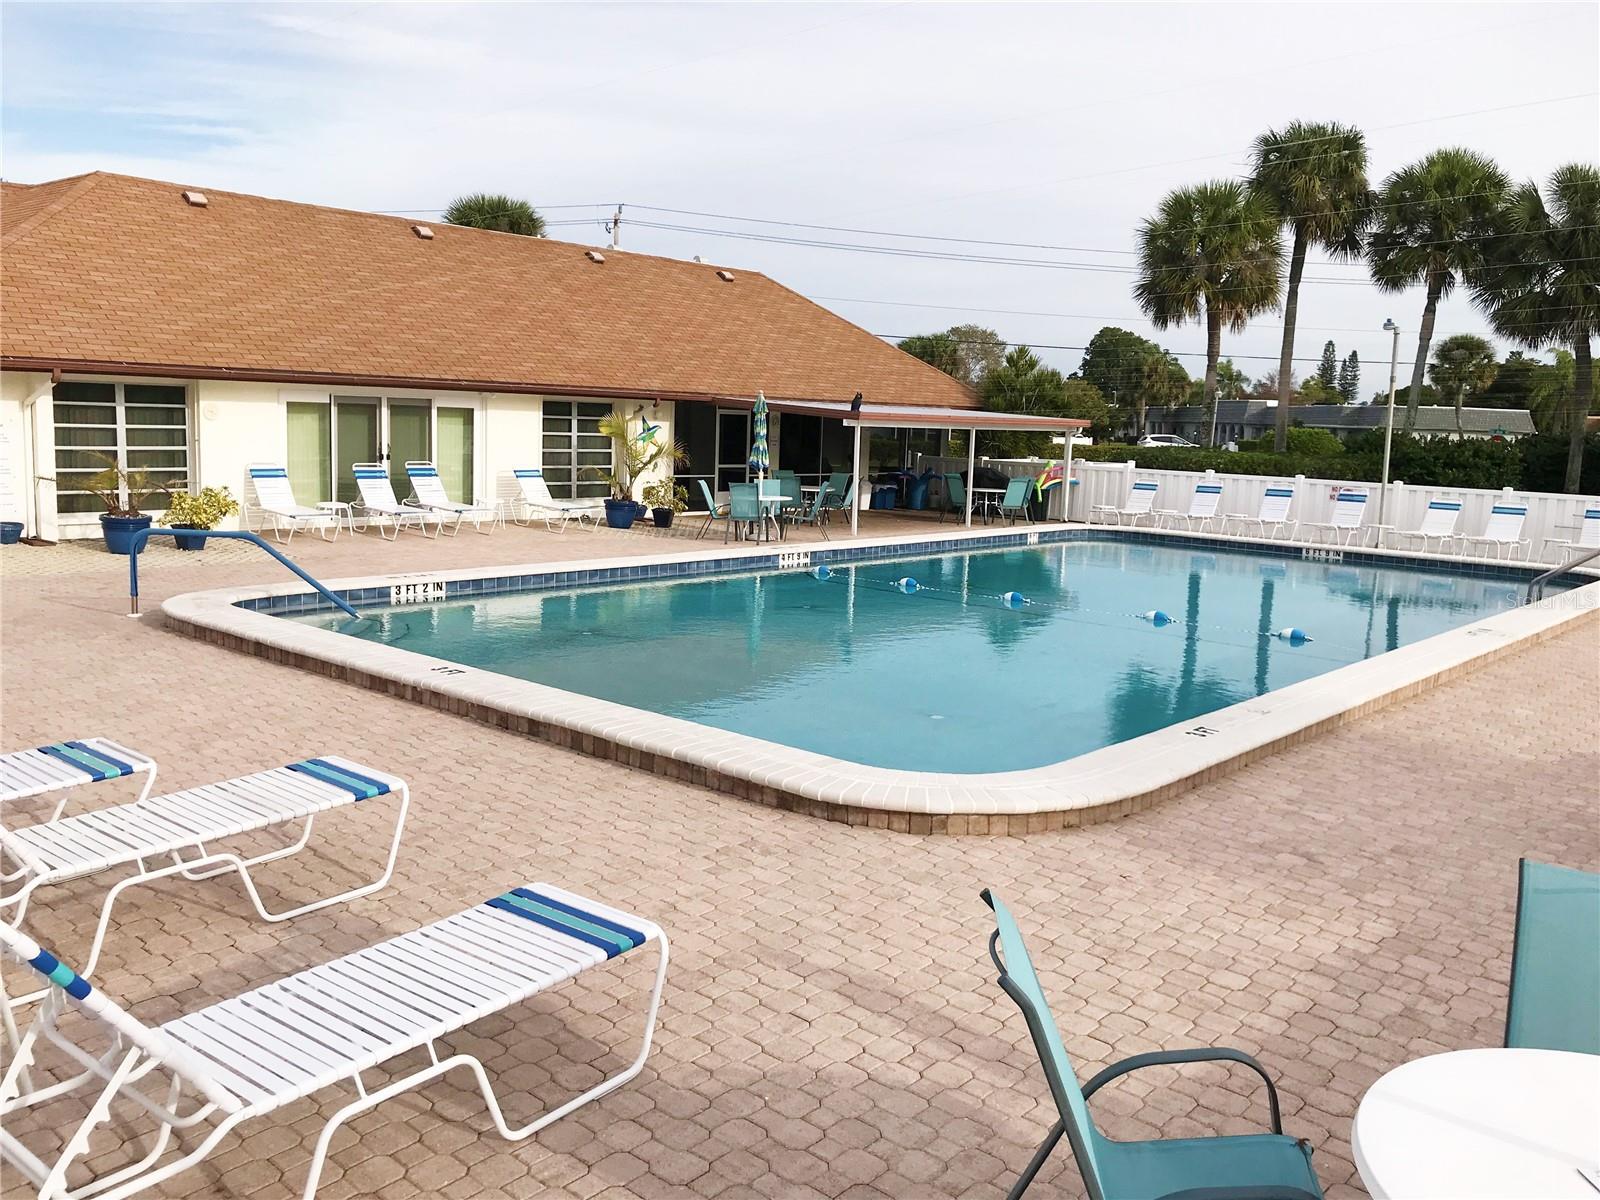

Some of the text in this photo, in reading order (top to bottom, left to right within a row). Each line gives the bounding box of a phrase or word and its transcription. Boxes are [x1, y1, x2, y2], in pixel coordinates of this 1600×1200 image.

[396, 584, 401, 596] 3
[423, 583, 429, 593] 2
[433, 582, 442, 592] IN
